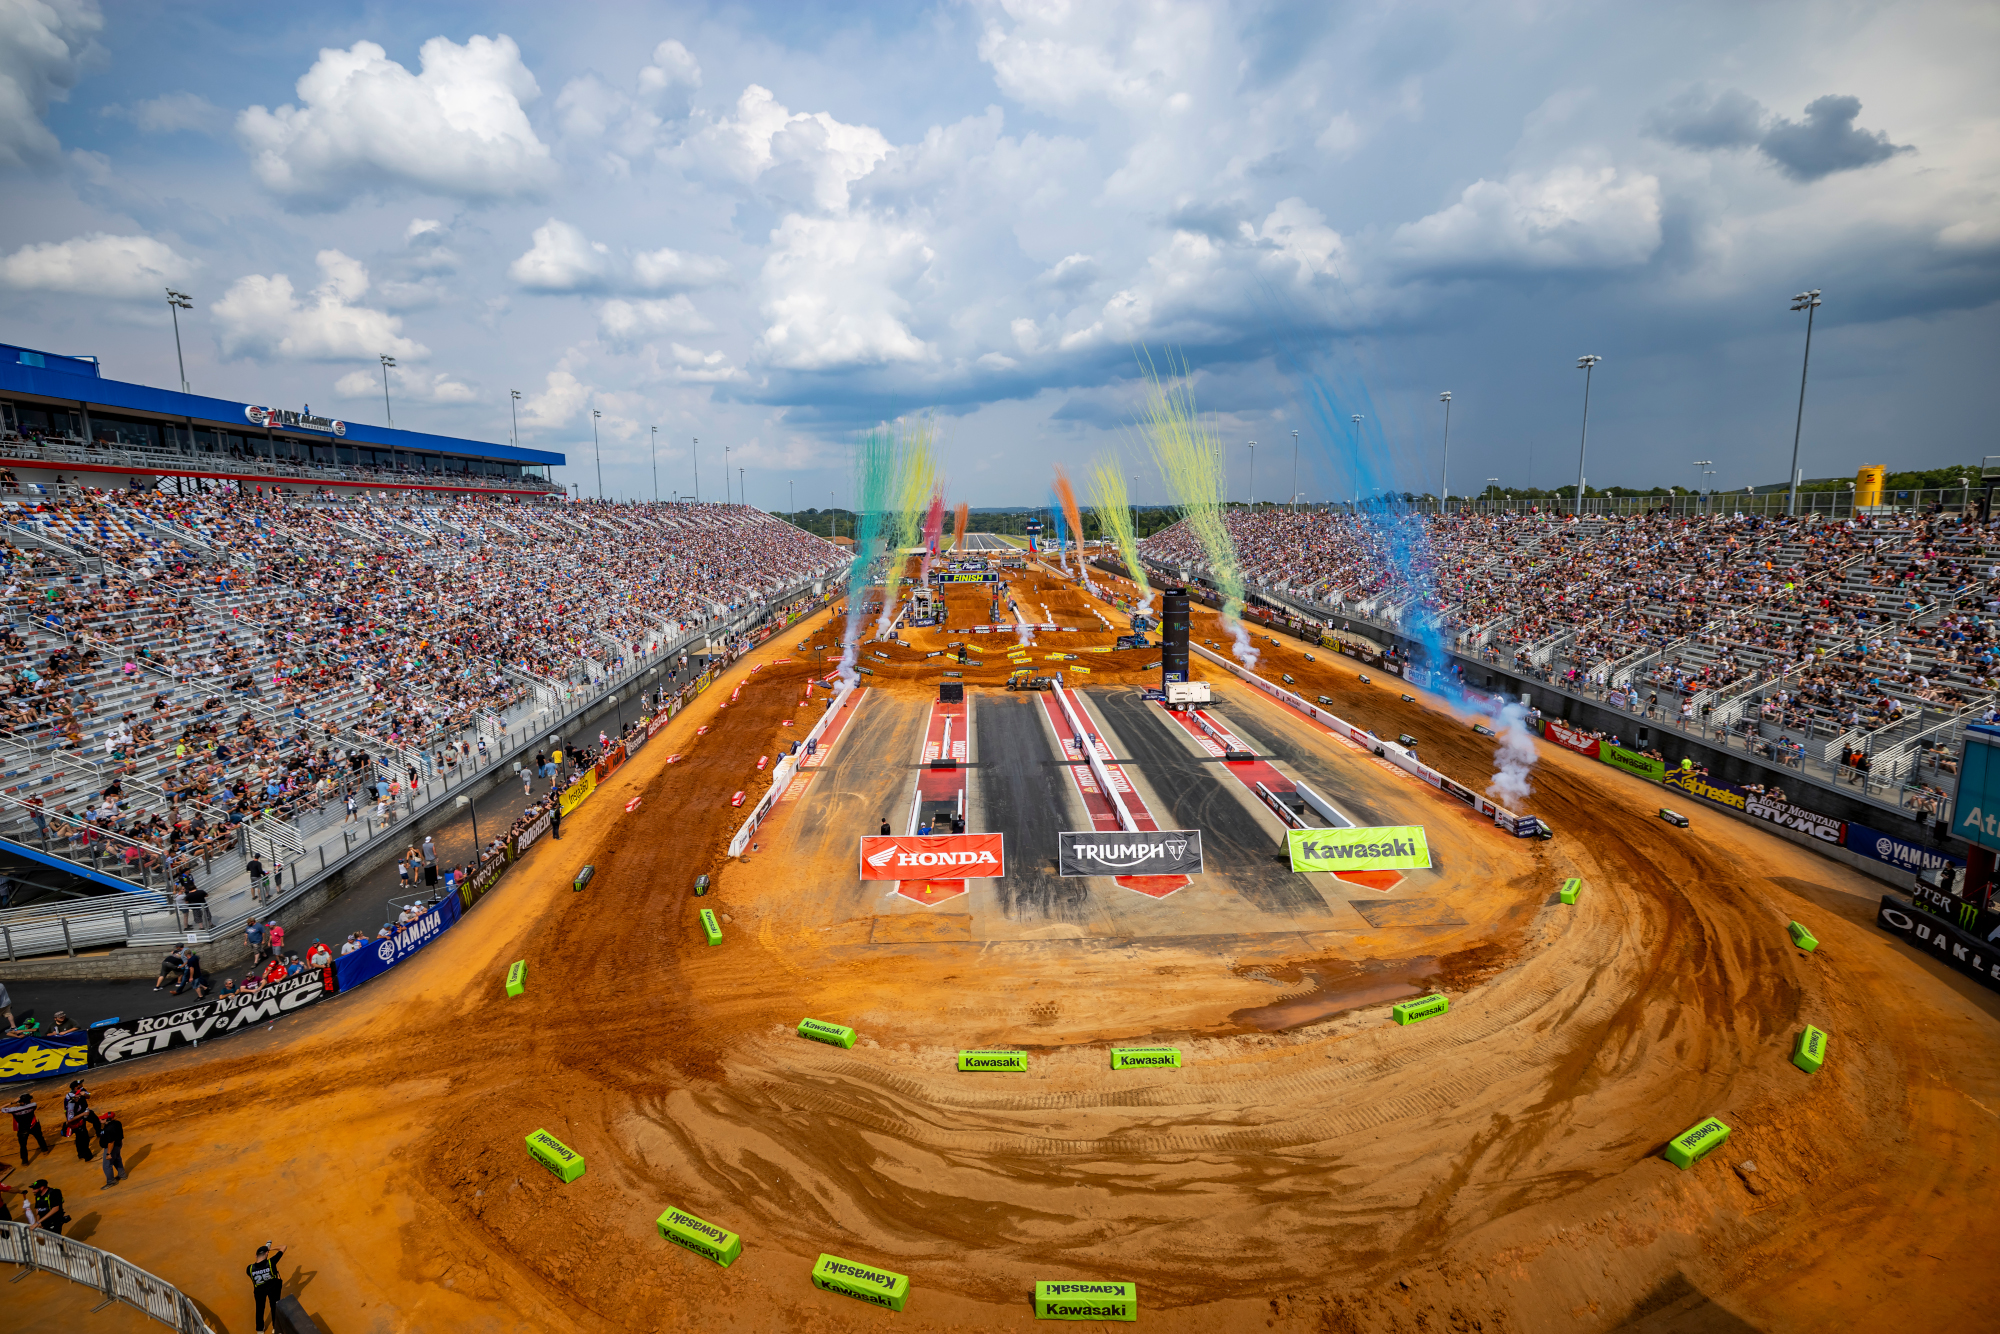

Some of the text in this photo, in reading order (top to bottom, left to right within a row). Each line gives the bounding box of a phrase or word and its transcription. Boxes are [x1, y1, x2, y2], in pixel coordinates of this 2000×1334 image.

[1322, 636, 1338, 650] SUZUKI
[1408, 670, 1427, 682] PARTS
[1610, 749, 1652, 774] Kawasaki
[568, 778, 588, 805] Insta360
[1683, 776, 1745, 810] alpinestars
[1663, 813, 1678, 825] UFO
[1758, 795, 1841, 830] ROCKY MOUNTAIN
[1963, 806, 2000, 838] At
[517, 811, 550, 854] PROGRESS
[898, 850, 998, 866] HONDA
[1072, 844, 1164, 867] TRIUMPH
[1302, 838, 1416, 860] Kawasaki
[472, 852, 506, 890] MONSTER
[394, 910, 442, 952] YAMAHA
[704, 910, 719, 934] Kawasaki
[386, 928, 440, 964] RACING
[510, 962, 520, 984] Kawasaki
[135, 1006, 211, 1035] ROCKY
[215, 969, 322, 1014] MOUNTAIN
[1400, 995, 1442, 1010] Kawasaki
[1408, 1004, 1445, 1021] Kawasaki
[802, 1020, 844, 1036] Kawasaki
[802, 1032, 842, 1048] Kawasaki
[1812, 1028, 1824, 1059] Kawasaki
[0, 1045, 88, 1078] stars
[965, 1058, 1020, 1067] Kawasaki
[1120, 1056, 1175, 1066] Kawasaki
[533, 1132, 576, 1162] Kawasaki
[1680, 1122, 1723, 1150] Kawasaki
[1690, 1136, 1728, 1164] Kawasaki
[667, 1212, 728, 1244] Kawasaki
[663, 1228, 720, 1262] Kawasaki
[252, 1268, 270, 1276] PHOTO
[254, 1272, 272, 1284] 25
[824, 1260, 896, 1290] Kawasaki
[821, 1280, 892, 1307] Kawasaki
[1046, 1284, 1126, 1296] Kawasaki
[1046, 1303, 1126, 1316] Kawasaki
